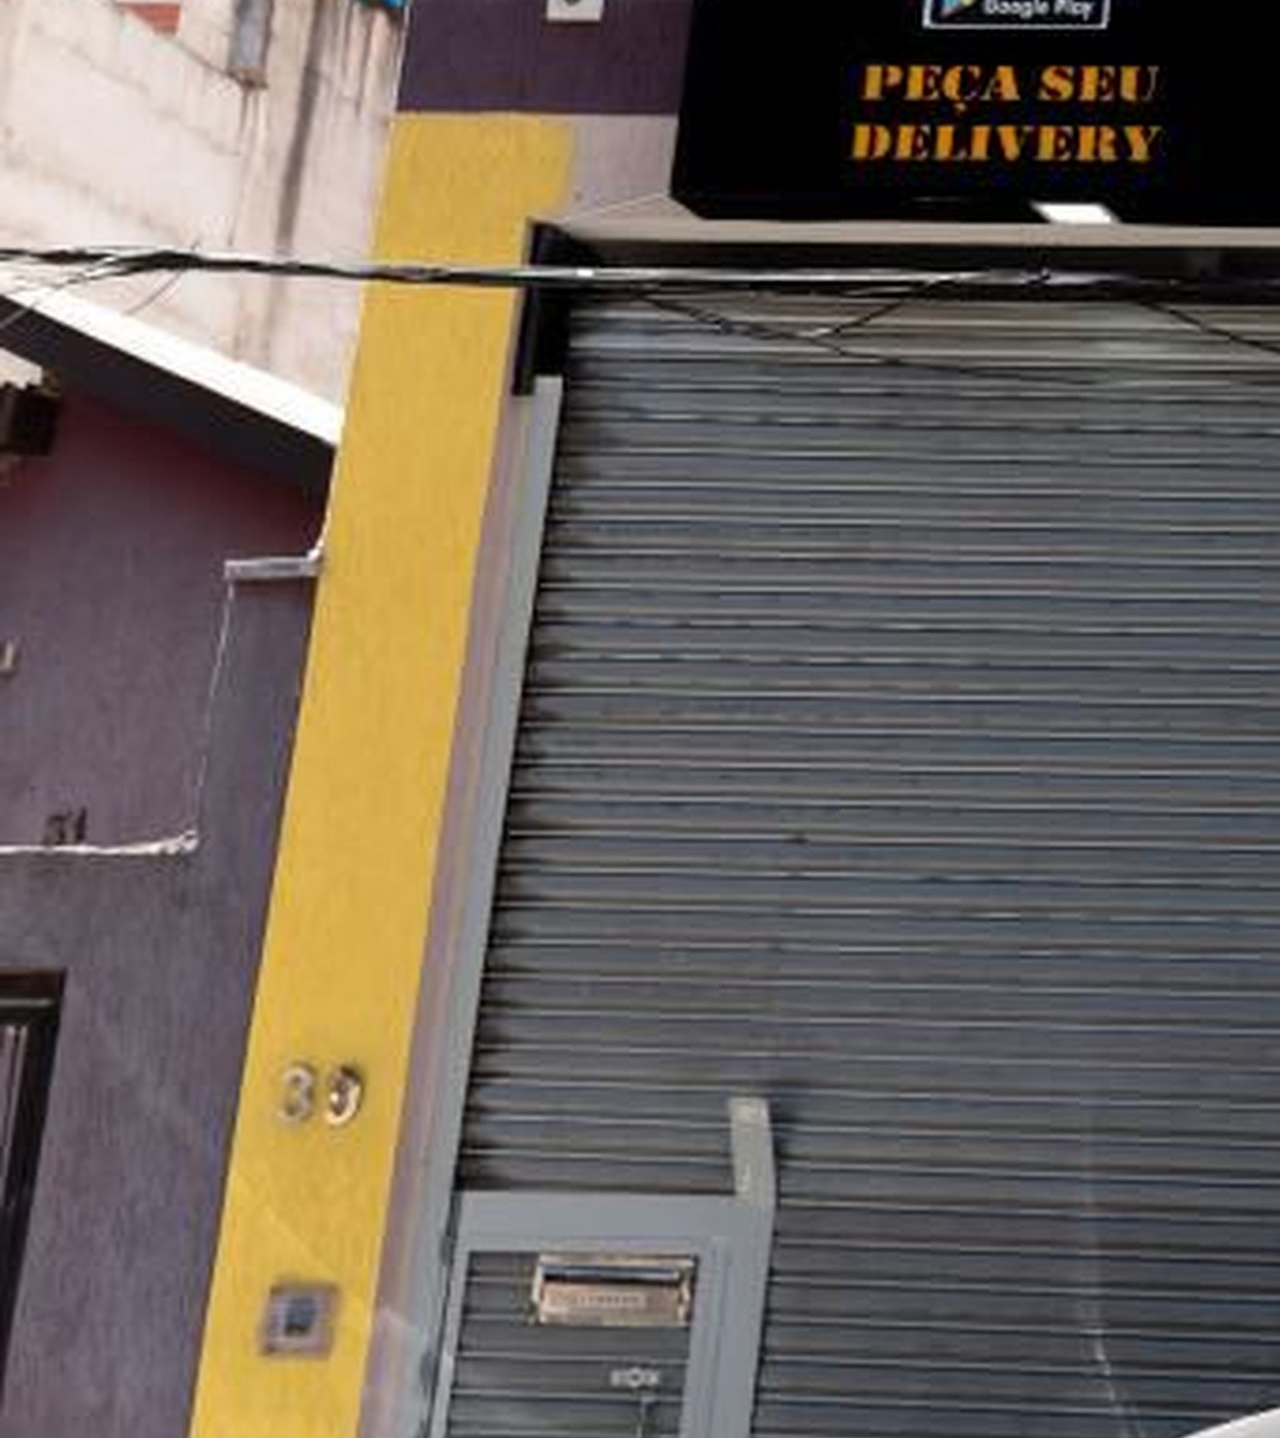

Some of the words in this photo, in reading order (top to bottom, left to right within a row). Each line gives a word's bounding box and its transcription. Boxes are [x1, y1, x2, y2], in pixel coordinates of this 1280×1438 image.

[862, 64, 1021, 114] PEÇA
[1037, 64, 1160, 102] SEU
[850, 125, 1165, 161] DELIVERY
[278, 1060, 363, 1125] 39
